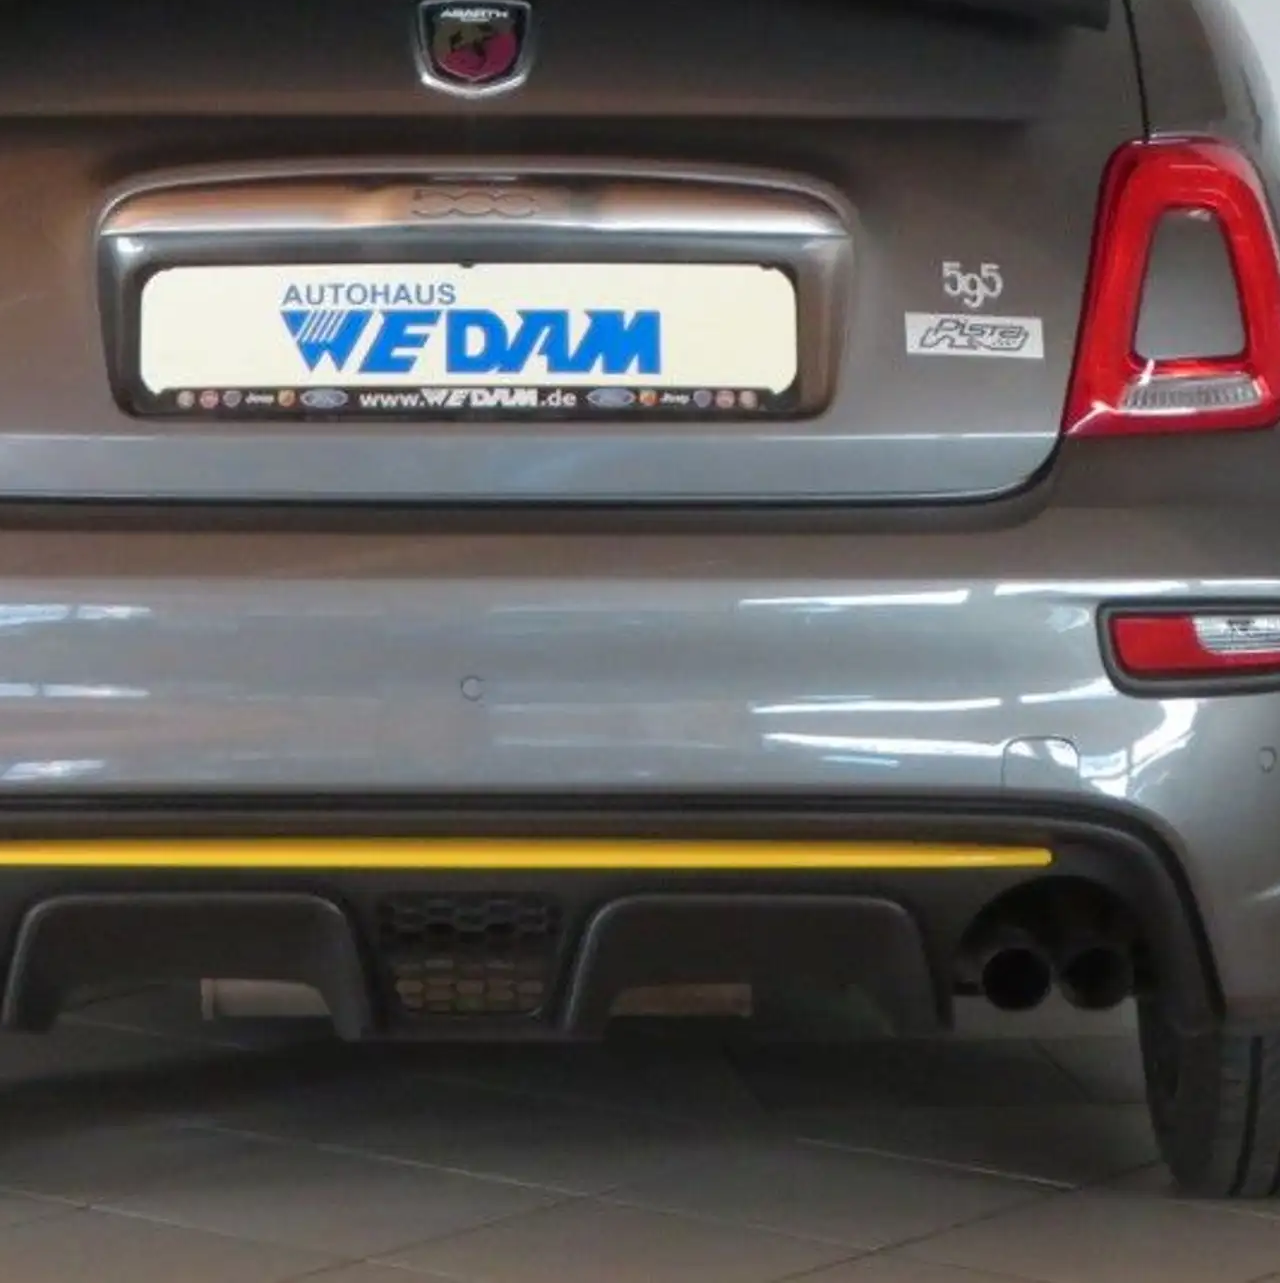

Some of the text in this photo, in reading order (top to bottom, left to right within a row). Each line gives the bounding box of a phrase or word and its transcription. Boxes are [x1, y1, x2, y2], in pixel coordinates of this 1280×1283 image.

[282, 283, 457, 306] AUTOHAUS
[942, 261, 1003, 308] 595
[280, 309, 661, 375] WEDAM
[359, 387, 577, 409] www.WEDAM.de
